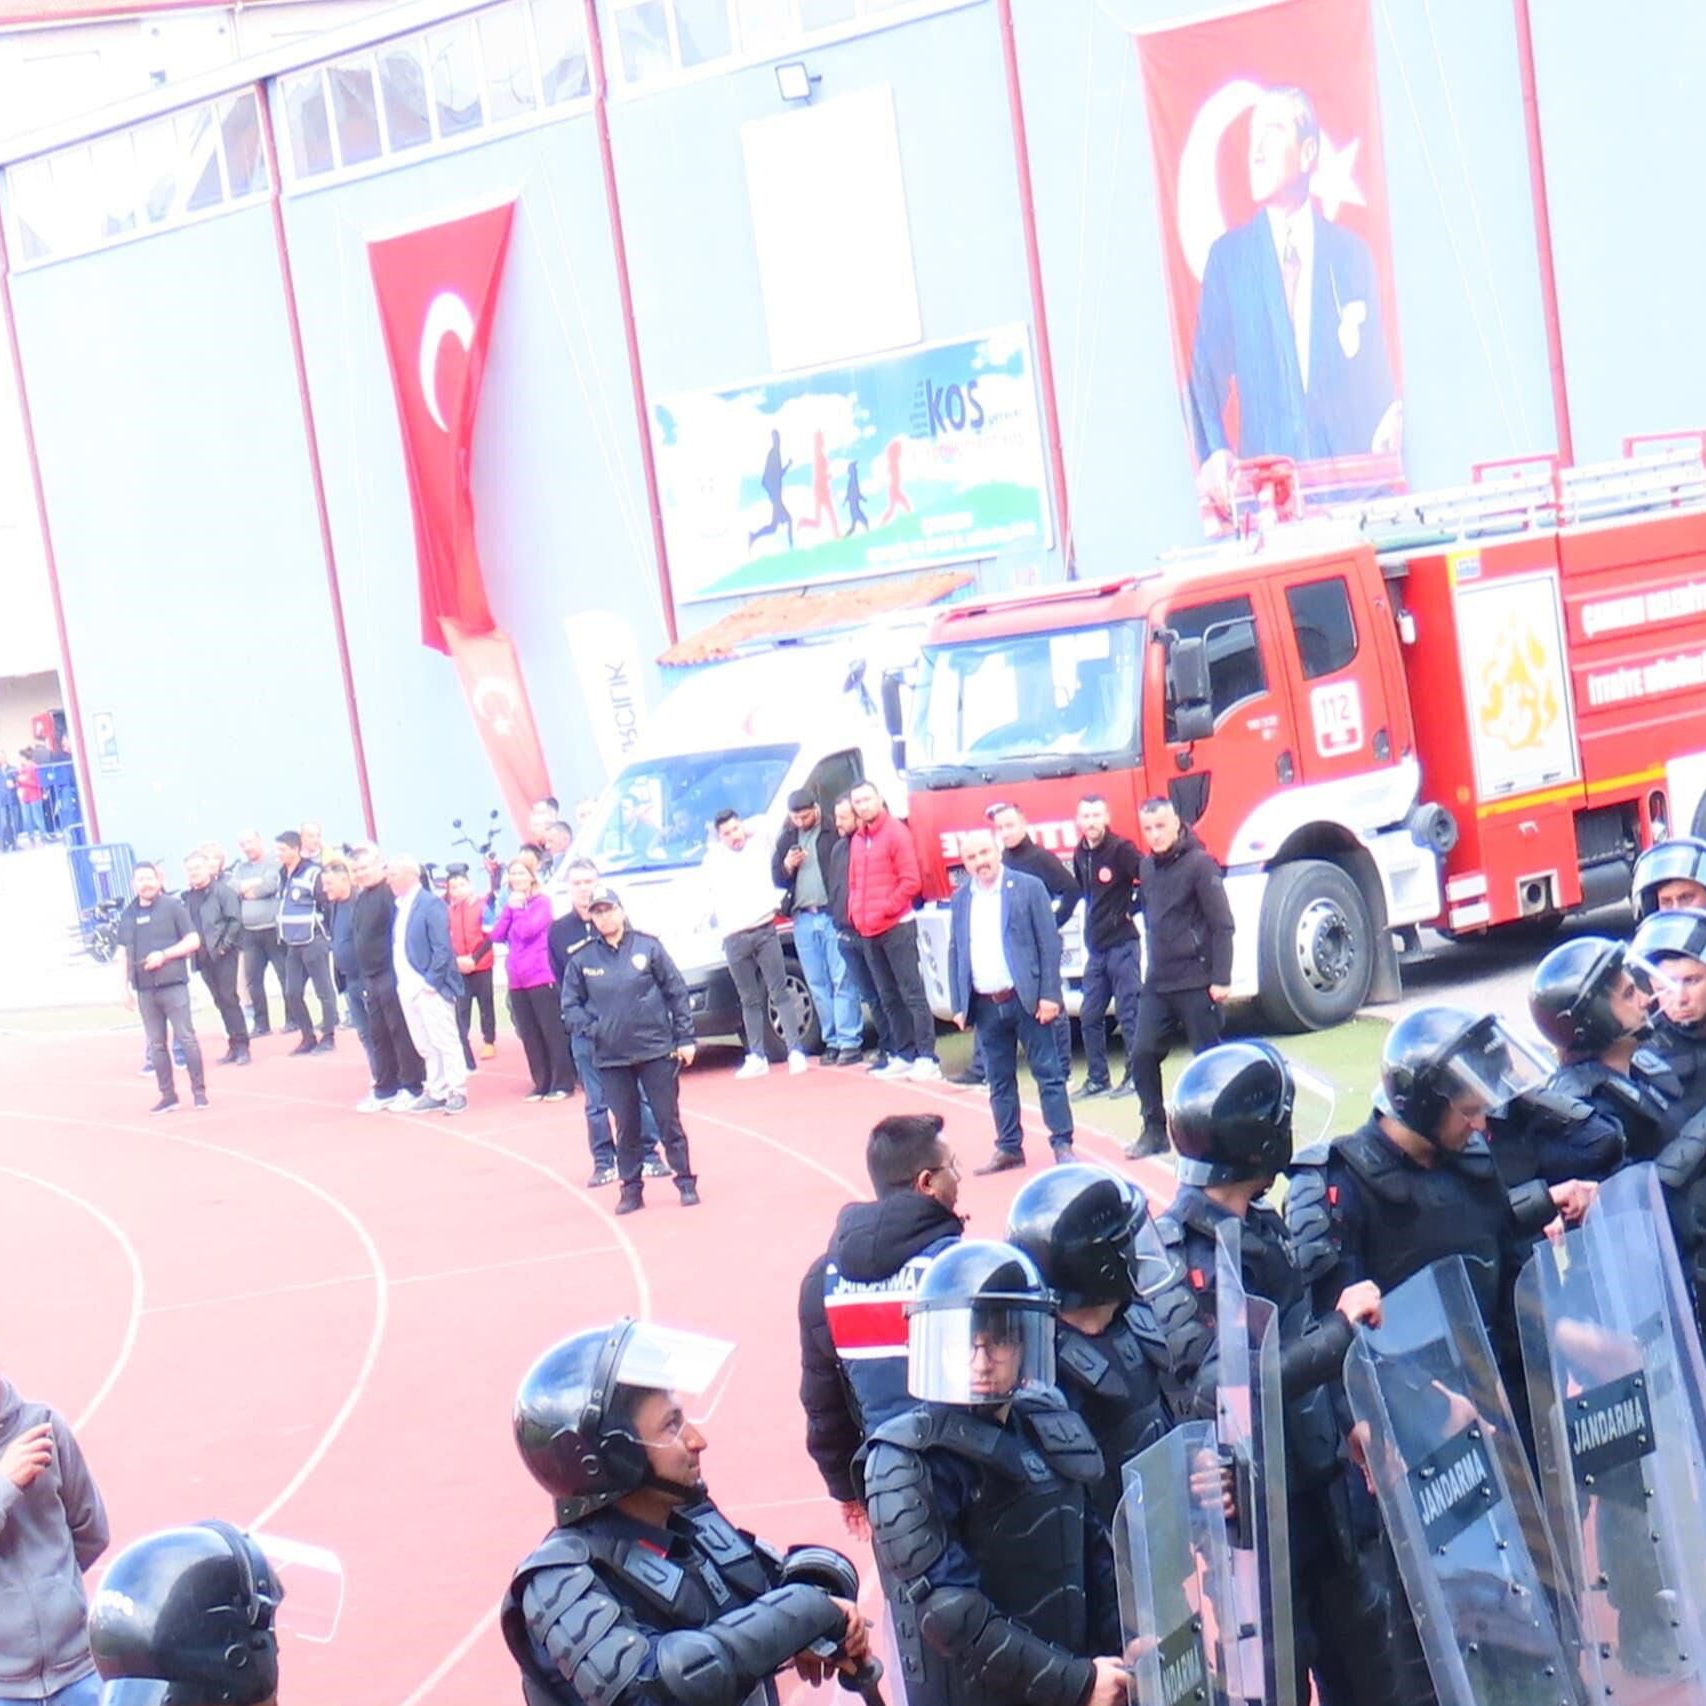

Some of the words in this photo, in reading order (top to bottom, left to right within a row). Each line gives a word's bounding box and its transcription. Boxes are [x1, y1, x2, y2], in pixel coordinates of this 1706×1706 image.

[1320, 693, 1351, 725] 112
[1574, 1395, 1646, 1456] JANDARMA
[1418, 1448, 1488, 1526] JANDARMA
